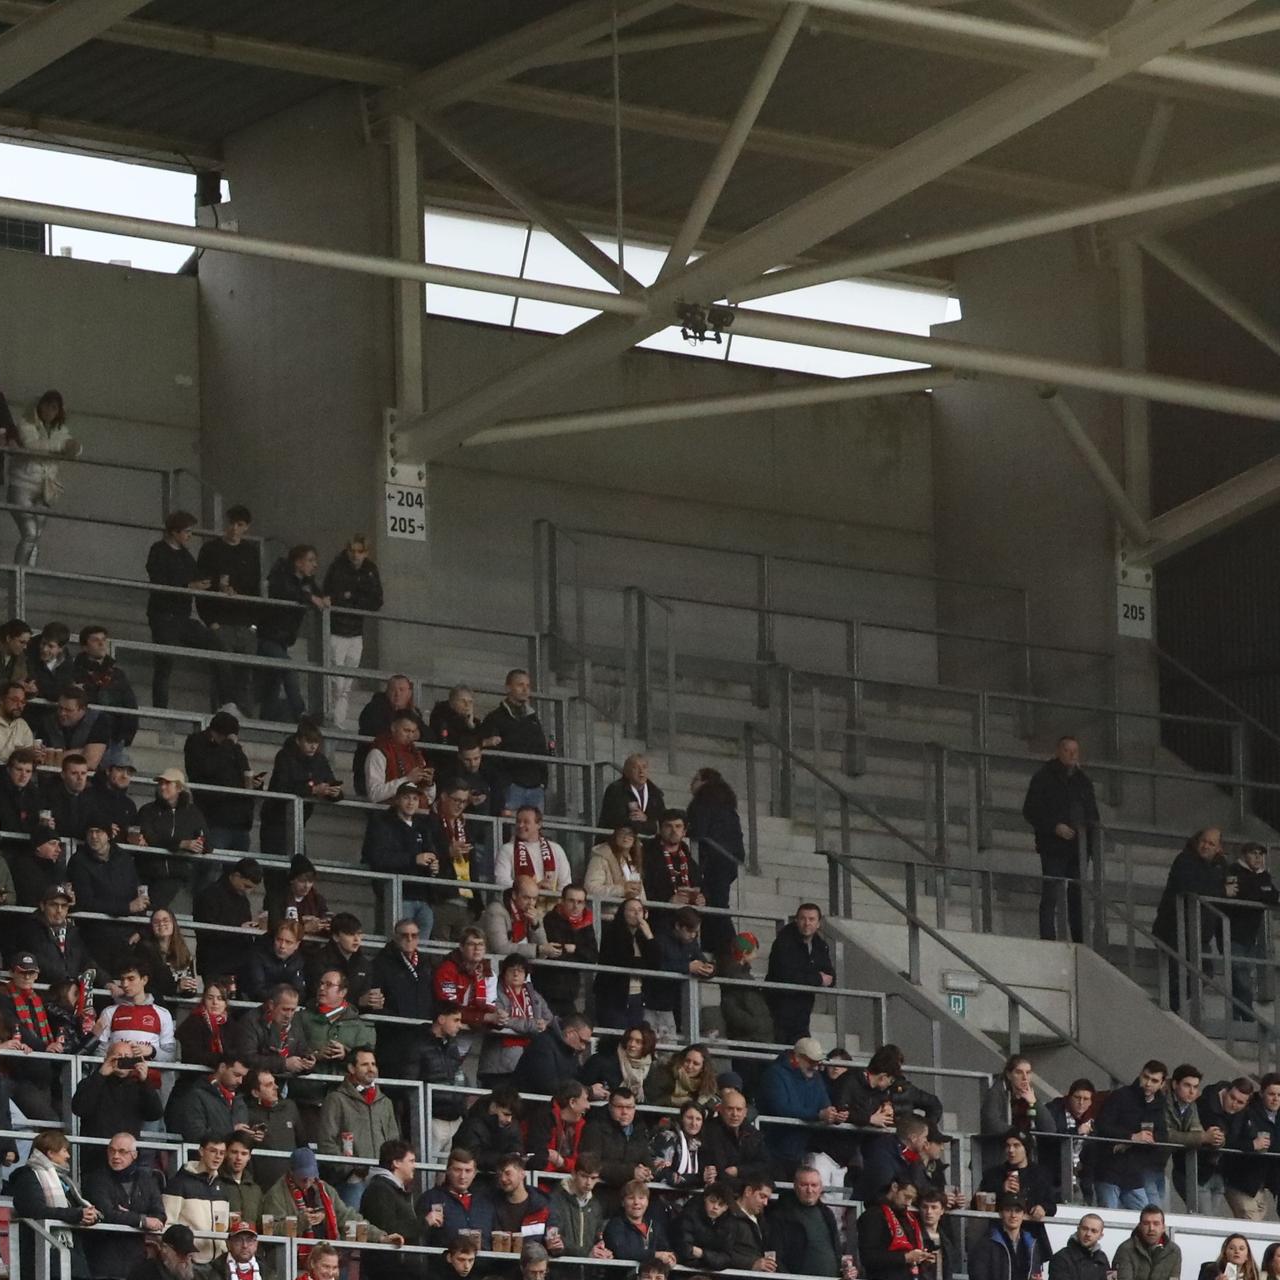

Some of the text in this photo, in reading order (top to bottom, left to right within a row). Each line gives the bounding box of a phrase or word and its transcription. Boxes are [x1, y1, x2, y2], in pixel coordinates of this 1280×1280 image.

[397, 490, 424, 508] 204
[390, 516, 416, 534] 205
[1123, 603, 1145, 621] 205
